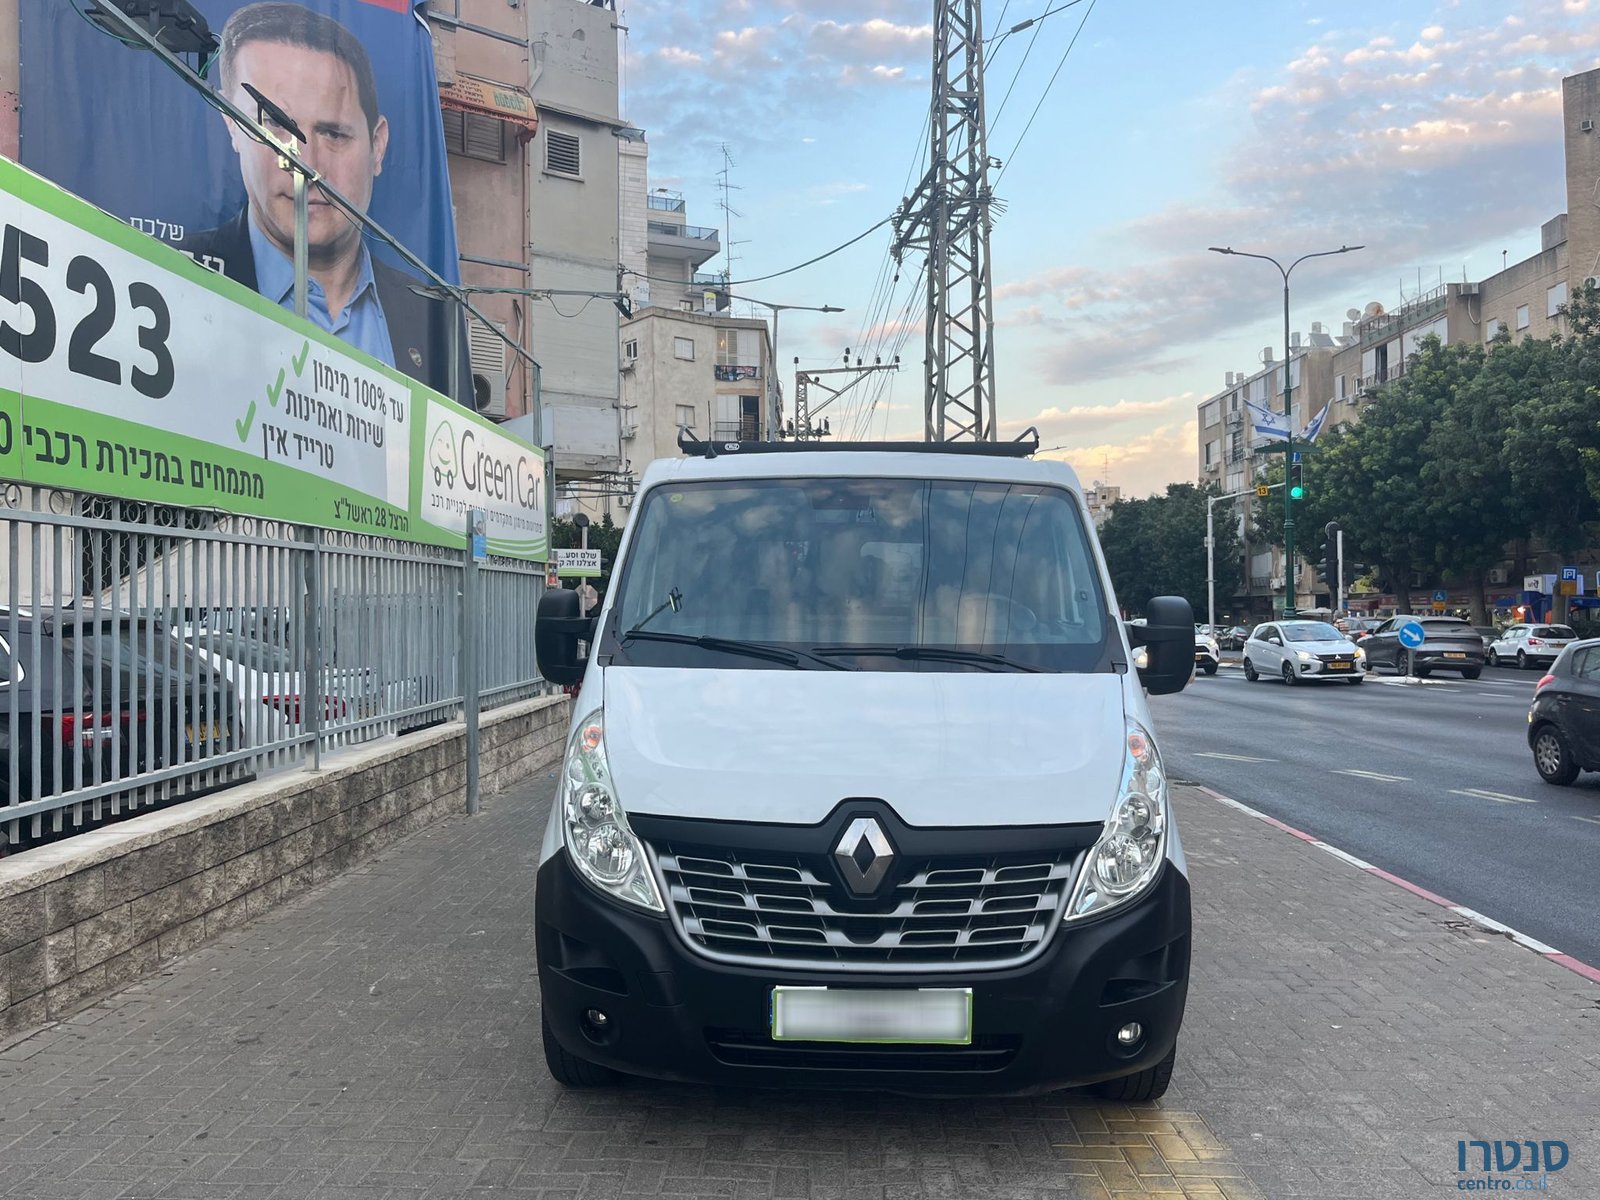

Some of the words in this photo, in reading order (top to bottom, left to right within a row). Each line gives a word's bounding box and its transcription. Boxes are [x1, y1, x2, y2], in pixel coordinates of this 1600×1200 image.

[312, 359, 350, 399] מימון
[353, 376, 387, 416] 100%
[285, 388, 343, 434] ואמינות
[389, 397, 404, 423] עד
[22, 424, 88, 469] רכבי
[261, 422, 289, 460] אין
[346, 412, 384, 448] שירות
[95, 439, 185, 486] במכירת
[292, 432, 334, 469] טרייד
[190, 459, 264, 500] מתמחים
[461, 429, 514, 503] Green
[517, 455, 540, 511] Car
[431, 493, 444, 508] רכב
[446, 496, 467, 517] לקניית
[1258, 487, 1267, 495] 13
[374, 506, 387, 528] 28
[388, 508, 409, 533] הרצל
[576, 559, 597, 567] אצלנו
[580, 551, 597, 560] שלם
